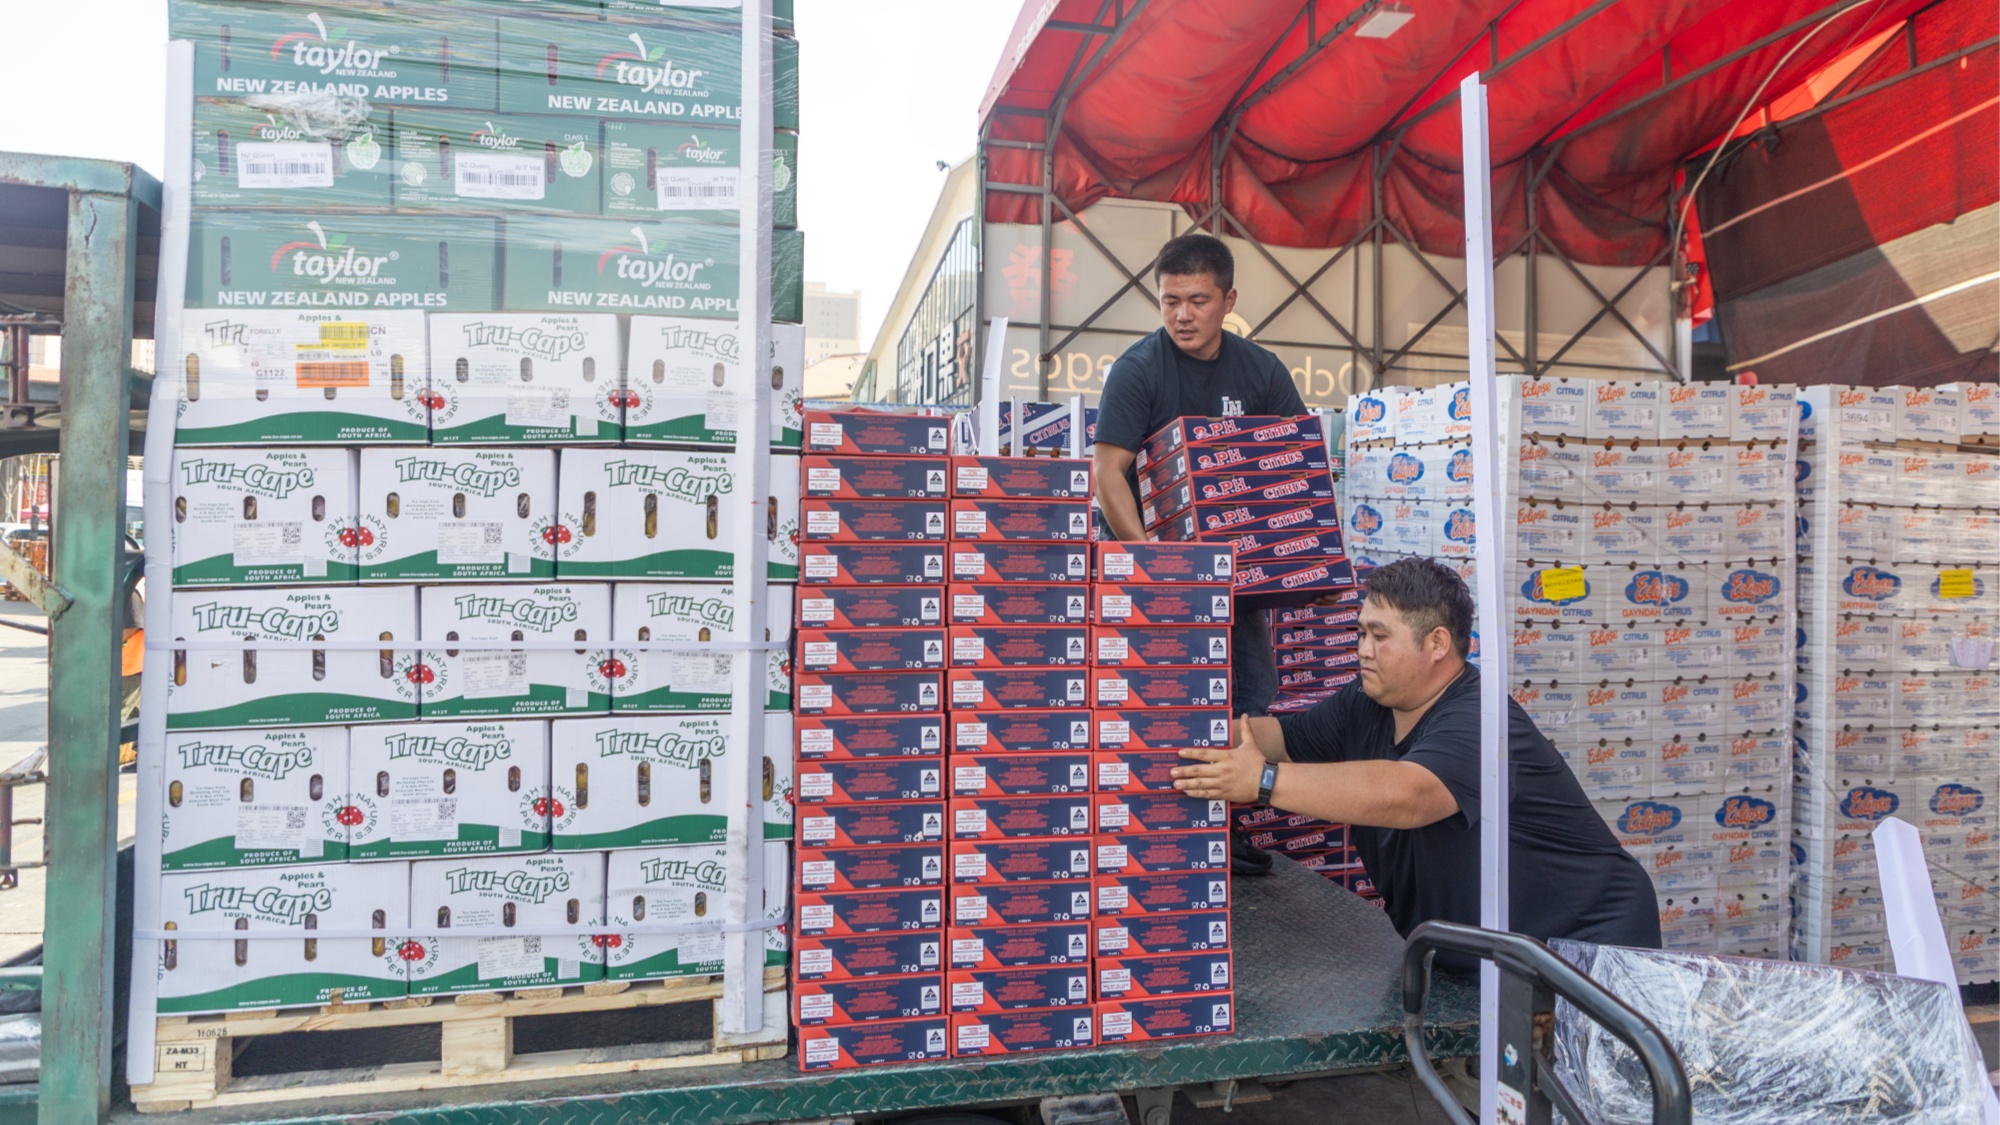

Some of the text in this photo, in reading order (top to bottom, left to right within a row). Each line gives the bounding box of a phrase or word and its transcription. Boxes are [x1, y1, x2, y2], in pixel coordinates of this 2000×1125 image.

[293, 40, 389, 75] taylor
[336, 68, 397, 78] NEW ZEALAND
[616, 61, 702, 93] taylor
[217, 78, 448, 101] NEW ZEALAND APPLES
[673, 89, 709, 98] ZEALAND
[548, 95, 742, 119] NEW ZEALAND APPLE
[261, 125, 302, 143] taylor
[480, 133, 520, 149] taylor
[686, 147, 723, 162] taylor
[293, 248, 389, 285] taylor
[617, 254, 704, 287] taylor
[674, 282, 711, 290] ZEALAND
[218, 291, 447, 307] NEW ZEALAND APPLES
[548, 291, 739, 311] NEW ZEALAND APPL
[298, 314, 332, 323] Apples
[370, 326, 386, 335] CN
[463, 321, 585, 362] Tru-Cape
[256, 368, 285, 377] C1122
[1521, 381, 1585, 399] Eclipse CITRUS
[1597, 385, 1656, 404] Eclipse CITRUS
[1669, 386, 1727, 404] Eclipse CITRUS
[1740, 389, 1792, 407] Eclipse CITRUS
[1418, 398, 1433, 407] CITRUS
[1030, 418, 1070, 443] CITRUS
[1254, 423, 1299, 442] CITRUS
[1372, 426, 1387, 434] CITRUS
[266, 452, 297, 460] Apples
[688, 456, 718, 464] Apples
[1259, 451, 1304, 470] CITRUS
[181, 458, 314, 499] Tru-Cape
[395, 457, 520, 498] Tru-Cape
[604, 459, 732, 505] Tru-Cape
[217, 484, 274, 498] SOUTH AFRICA
[1264, 480, 1309, 499] CITRUS
[1407, 486, 1425, 494] CITRUS
[1268, 509, 1313, 529] CITRUS
[1274, 537, 1320, 556] CITRUS
[1282, 567, 1329, 588] CITRUS
[287, 594, 321, 602] Apples
[1730, 575, 1773, 603] Eclipse
[455, 594, 577, 633] Tru-Cape
[647, 592, 734, 632] Tru-Ca
[1324, 612, 1358, 625] CITRUS
[1518, 607, 1593, 617] GAYNDAH CITRUS
[1622, 607, 1692, 617] GAYNDAH CITRUS
[1718, 606, 1756, 615] GAYNDAH
[193, 602, 339, 641] Tru-Cape
[1324, 654, 1358, 666] CITRUS
[1324, 674, 1357, 687] CITRUS
[265, 733, 297, 741] Apples
[385, 733, 511, 772] Tru-Cape
[596, 729, 725, 769] Tru-Cape
[1620, 750, 1647, 758] CITRUS
[179, 741, 312, 780] Tru-Cape
[243, 770, 271, 779] AFRICA
[1724, 799, 1769, 827] Eclipse
[1286, 833, 1325, 850] CITRUS
[1619, 837, 1653, 847] AYNDAH
[1712, 830, 1778, 841] GAYNDAH CITRUS
[280, 872, 315, 881] Apples
[641, 858, 726, 888] Tru-Ca
[446, 867, 569, 904] Tru-Cape
[185, 883, 331, 926] Tru-Cape
